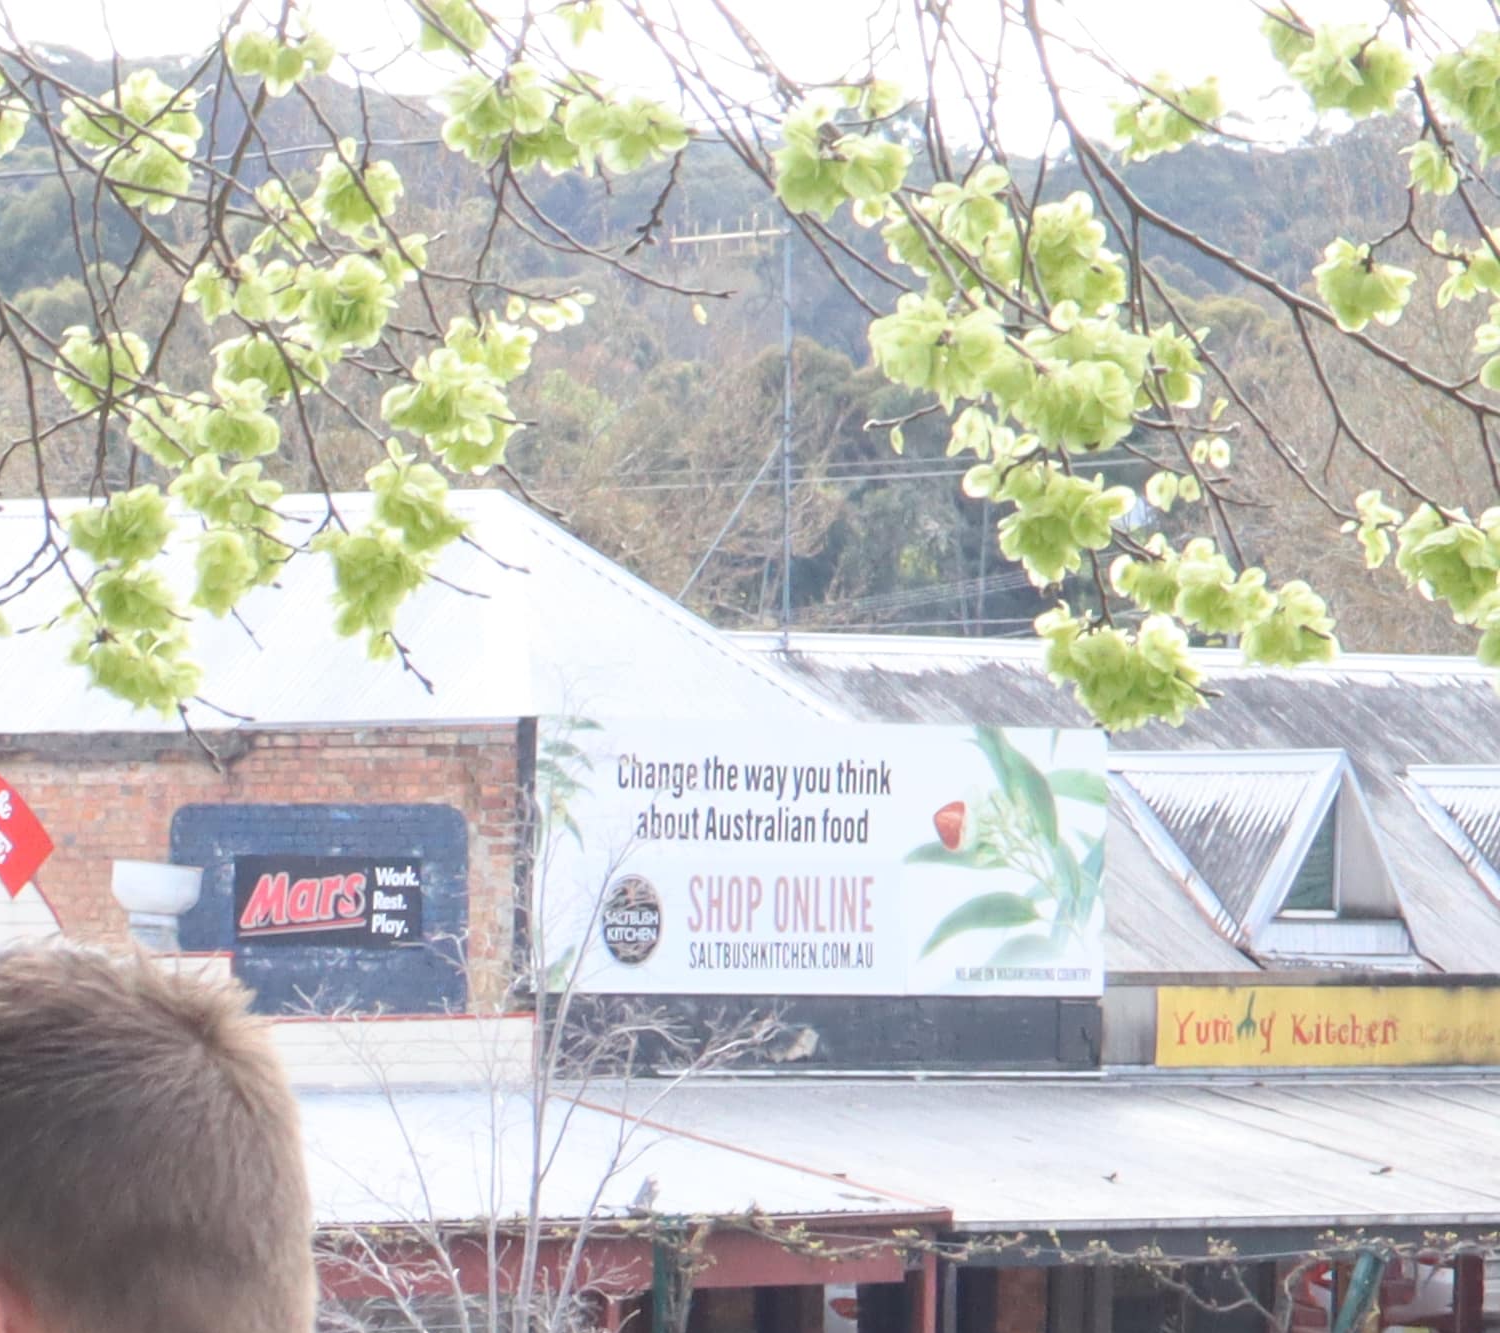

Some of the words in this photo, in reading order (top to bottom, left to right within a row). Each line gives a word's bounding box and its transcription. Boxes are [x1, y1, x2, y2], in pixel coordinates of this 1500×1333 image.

[617, 753, 698, 798] Change
[704, 755, 738, 791] the
[745, 763, 787, 801] way
[793, 765, 830, 801] you
[837, 759, 892, 795] think
[636, 803, 699, 840] about
[704, 806, 816, 842] Australian
[822, 807, 868, 844] food
[374, 865, 420, 887] Work.
[239, 871, 367, 930] Mars
[688, 874, 763, 934] SHOP
[773, 875, 875, 934] ONLINE
[689, 942, 874, 969] SALTBUSHKITCHEN.COM.AU
[1290, 1010, 1400, 1047] Kitchen
